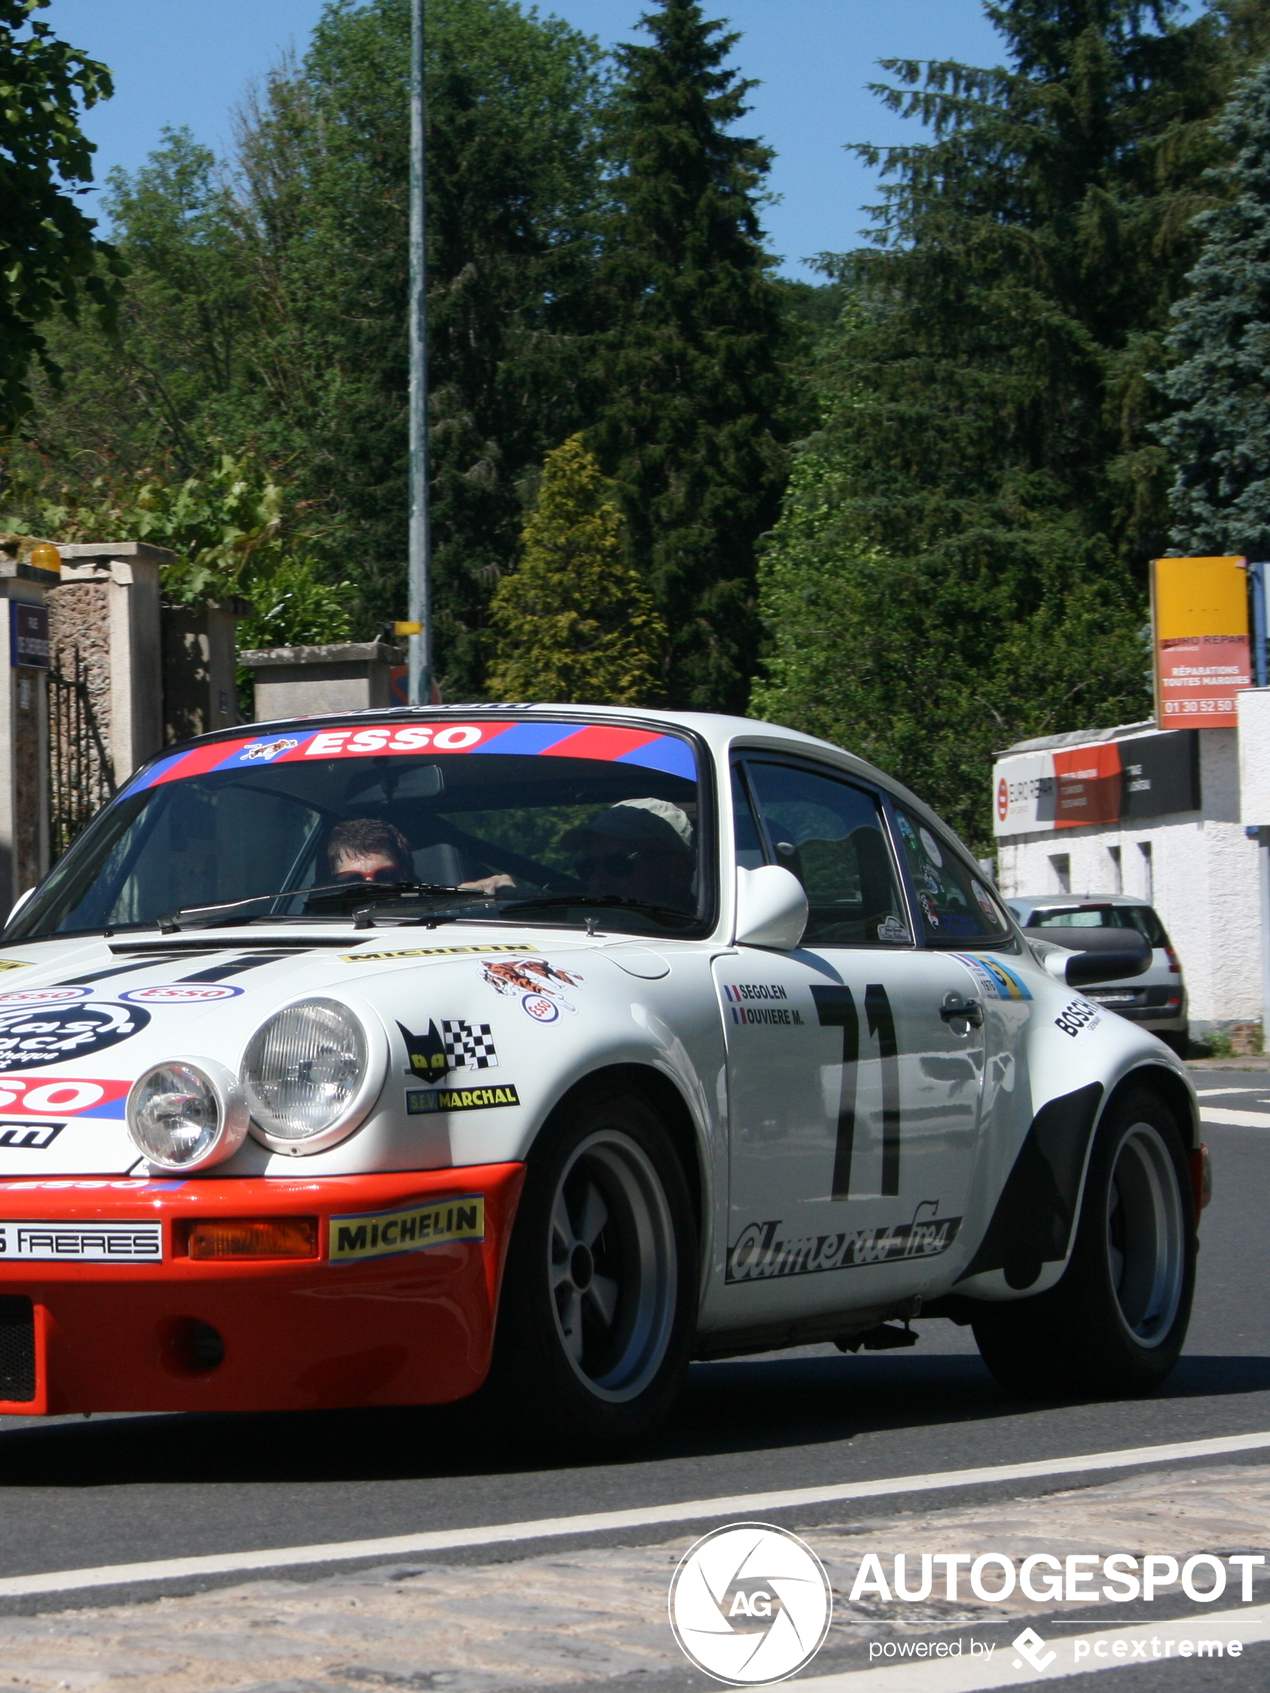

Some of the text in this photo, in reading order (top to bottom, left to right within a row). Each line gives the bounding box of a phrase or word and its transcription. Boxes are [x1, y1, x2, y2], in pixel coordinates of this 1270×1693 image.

[1172, 666, 1240, 677] RÉPARATIONS
[1163, 676, 1250, 687] TOUTES MARQUES
[1165, 702, 1180, 713] 01
[1182, 701, 1198, 712] 30
[1200, 701, 1216, 712] 52
[1218, 700, 1233, 711] 50
[304, 726, 482, 756] ESSO
[347, 945, 530, 960] MICHELIN
[739, 984, 787, 999] SEGOLEN
[746, 1008, 805, 1026] OUVIERE M.
[1054, 997, 1099, 1038] BOSCH
[439, 1088, 517, 1108] MARCHAL
[809, 983, 900, 1202] 71
[6, 1180, 150, 1190] ESSO
[337, 1205, 477, 1252] MICHELIN
[17, 1228, 160, 1254] FRERES
